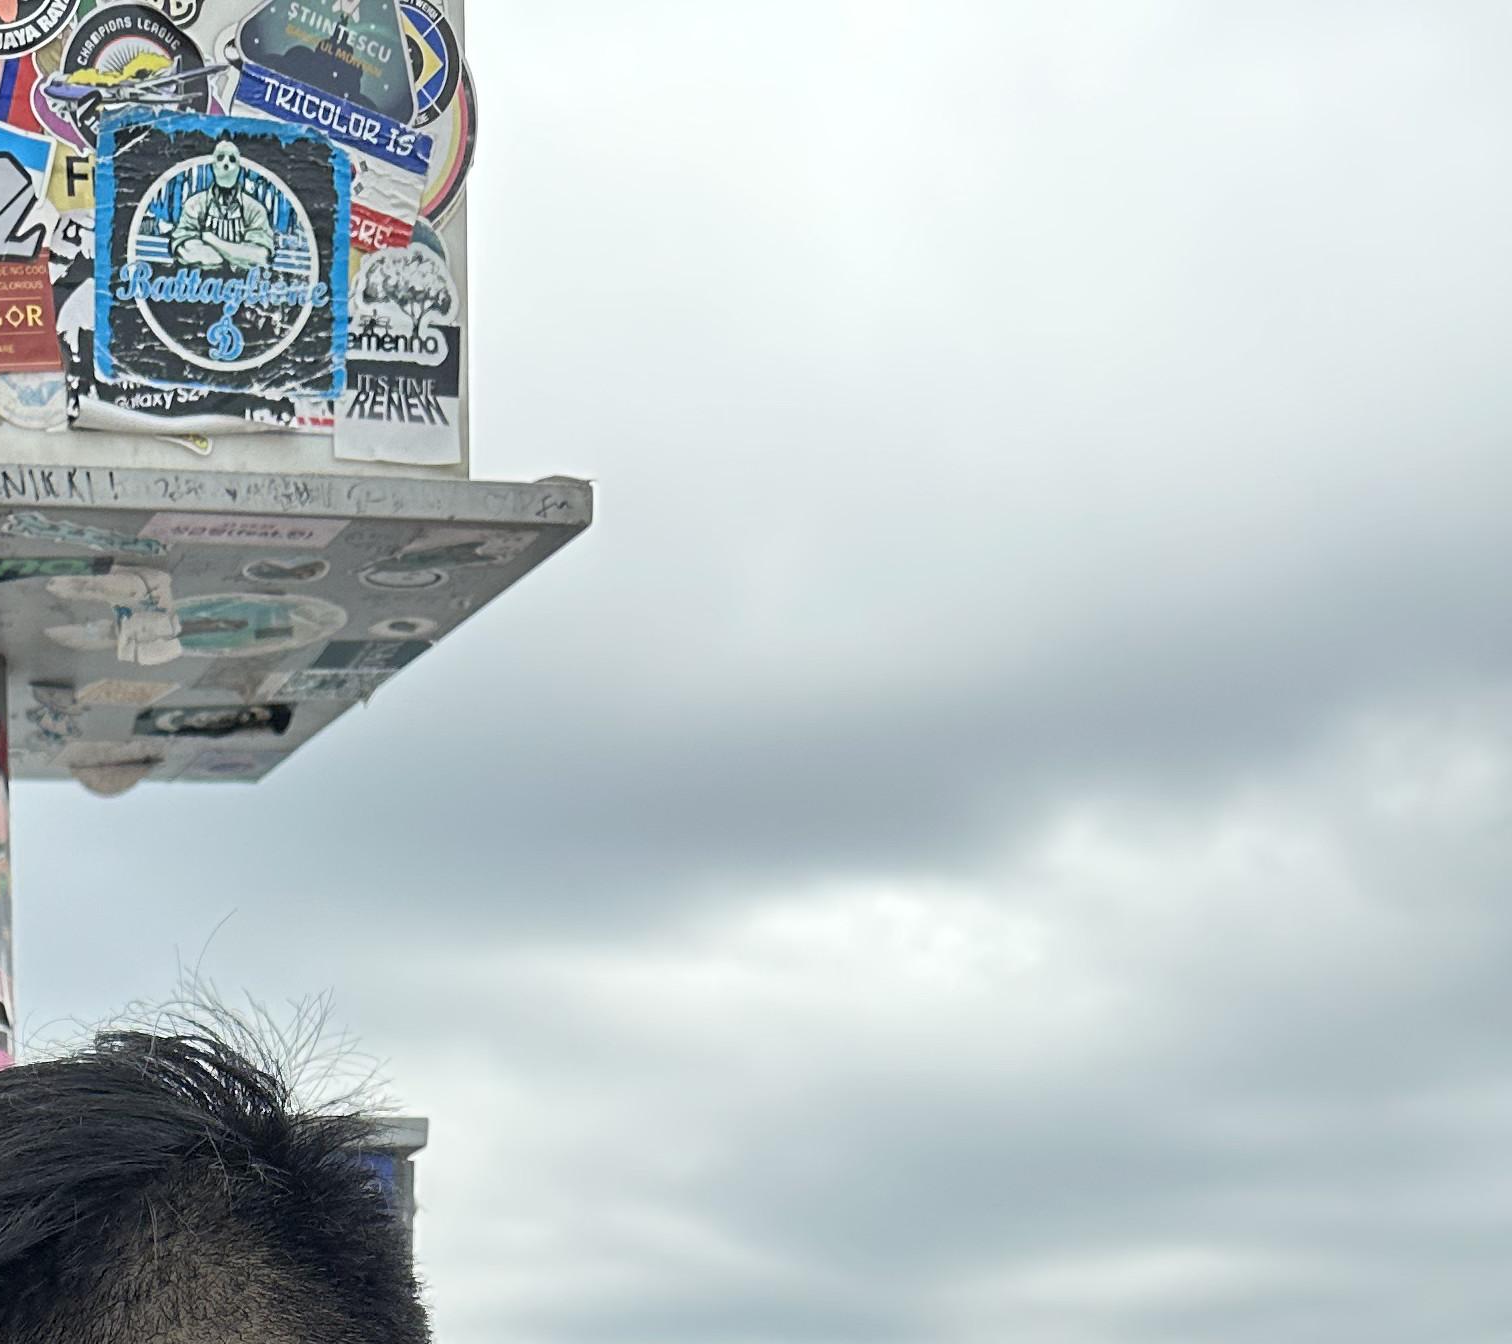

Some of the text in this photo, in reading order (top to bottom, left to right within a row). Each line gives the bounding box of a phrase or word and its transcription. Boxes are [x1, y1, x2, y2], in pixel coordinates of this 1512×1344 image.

[76, 16, 182, 67] CHAMPIONS LEAGUE
[115, 262, 330, 309] Battaglione
[346, 389, 451, 426] RENEW
